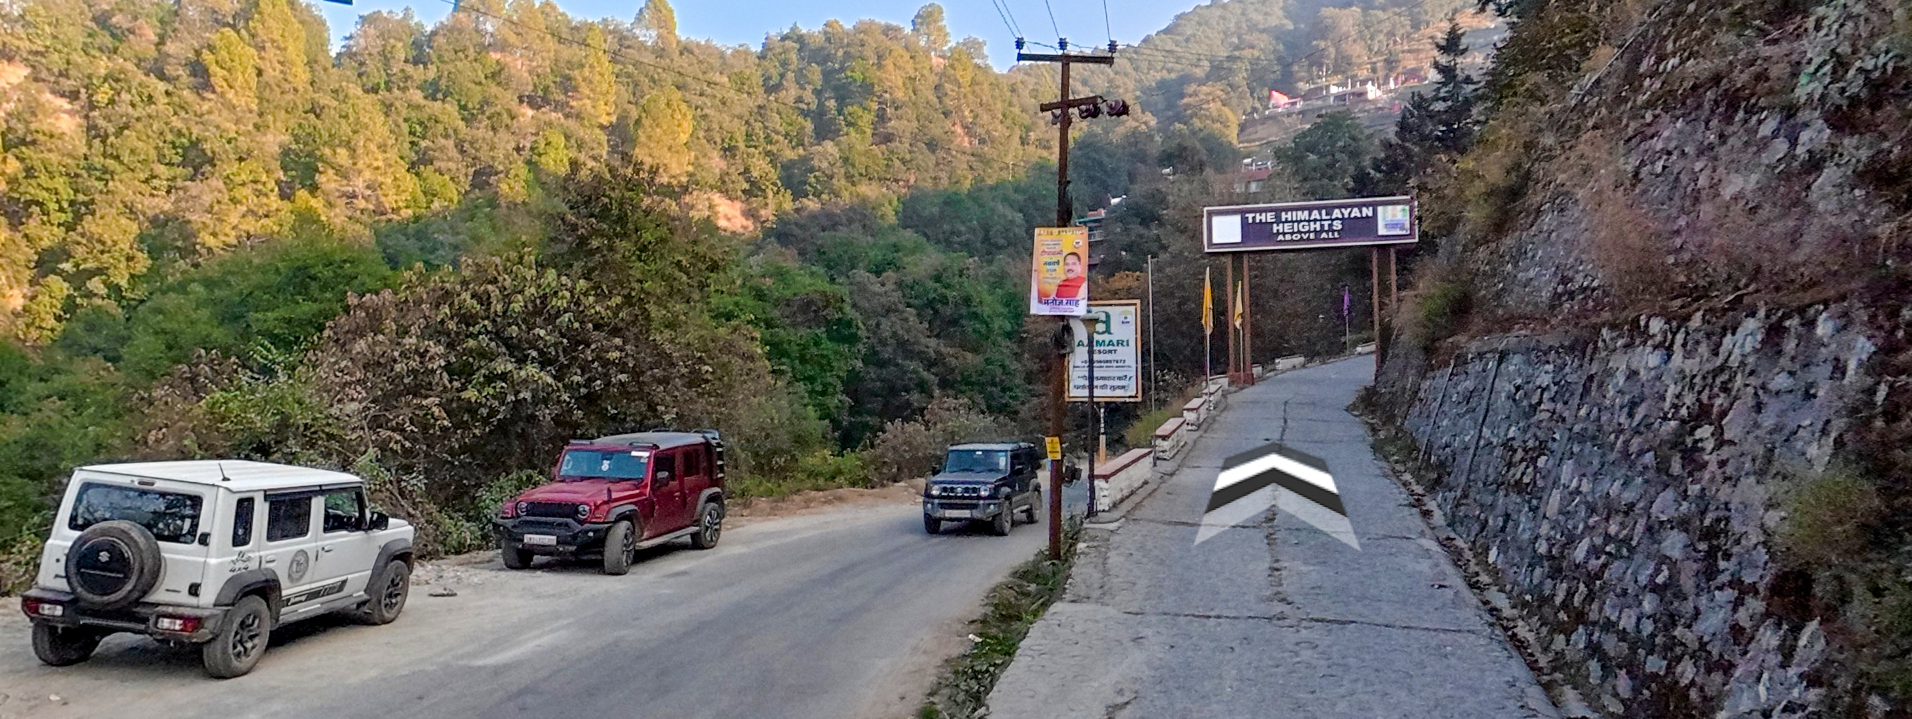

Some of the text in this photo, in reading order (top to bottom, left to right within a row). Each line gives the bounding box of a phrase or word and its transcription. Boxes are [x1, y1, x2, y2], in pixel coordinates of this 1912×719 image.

[1245, 207, 1373, 223] THE HIMALAYAN
[1272, 220, 1343, 233] HEIGHTS
[1276, 231, 1340, 241] ABOVE ALL
[1042, 297, 1063, 307] मनोज
